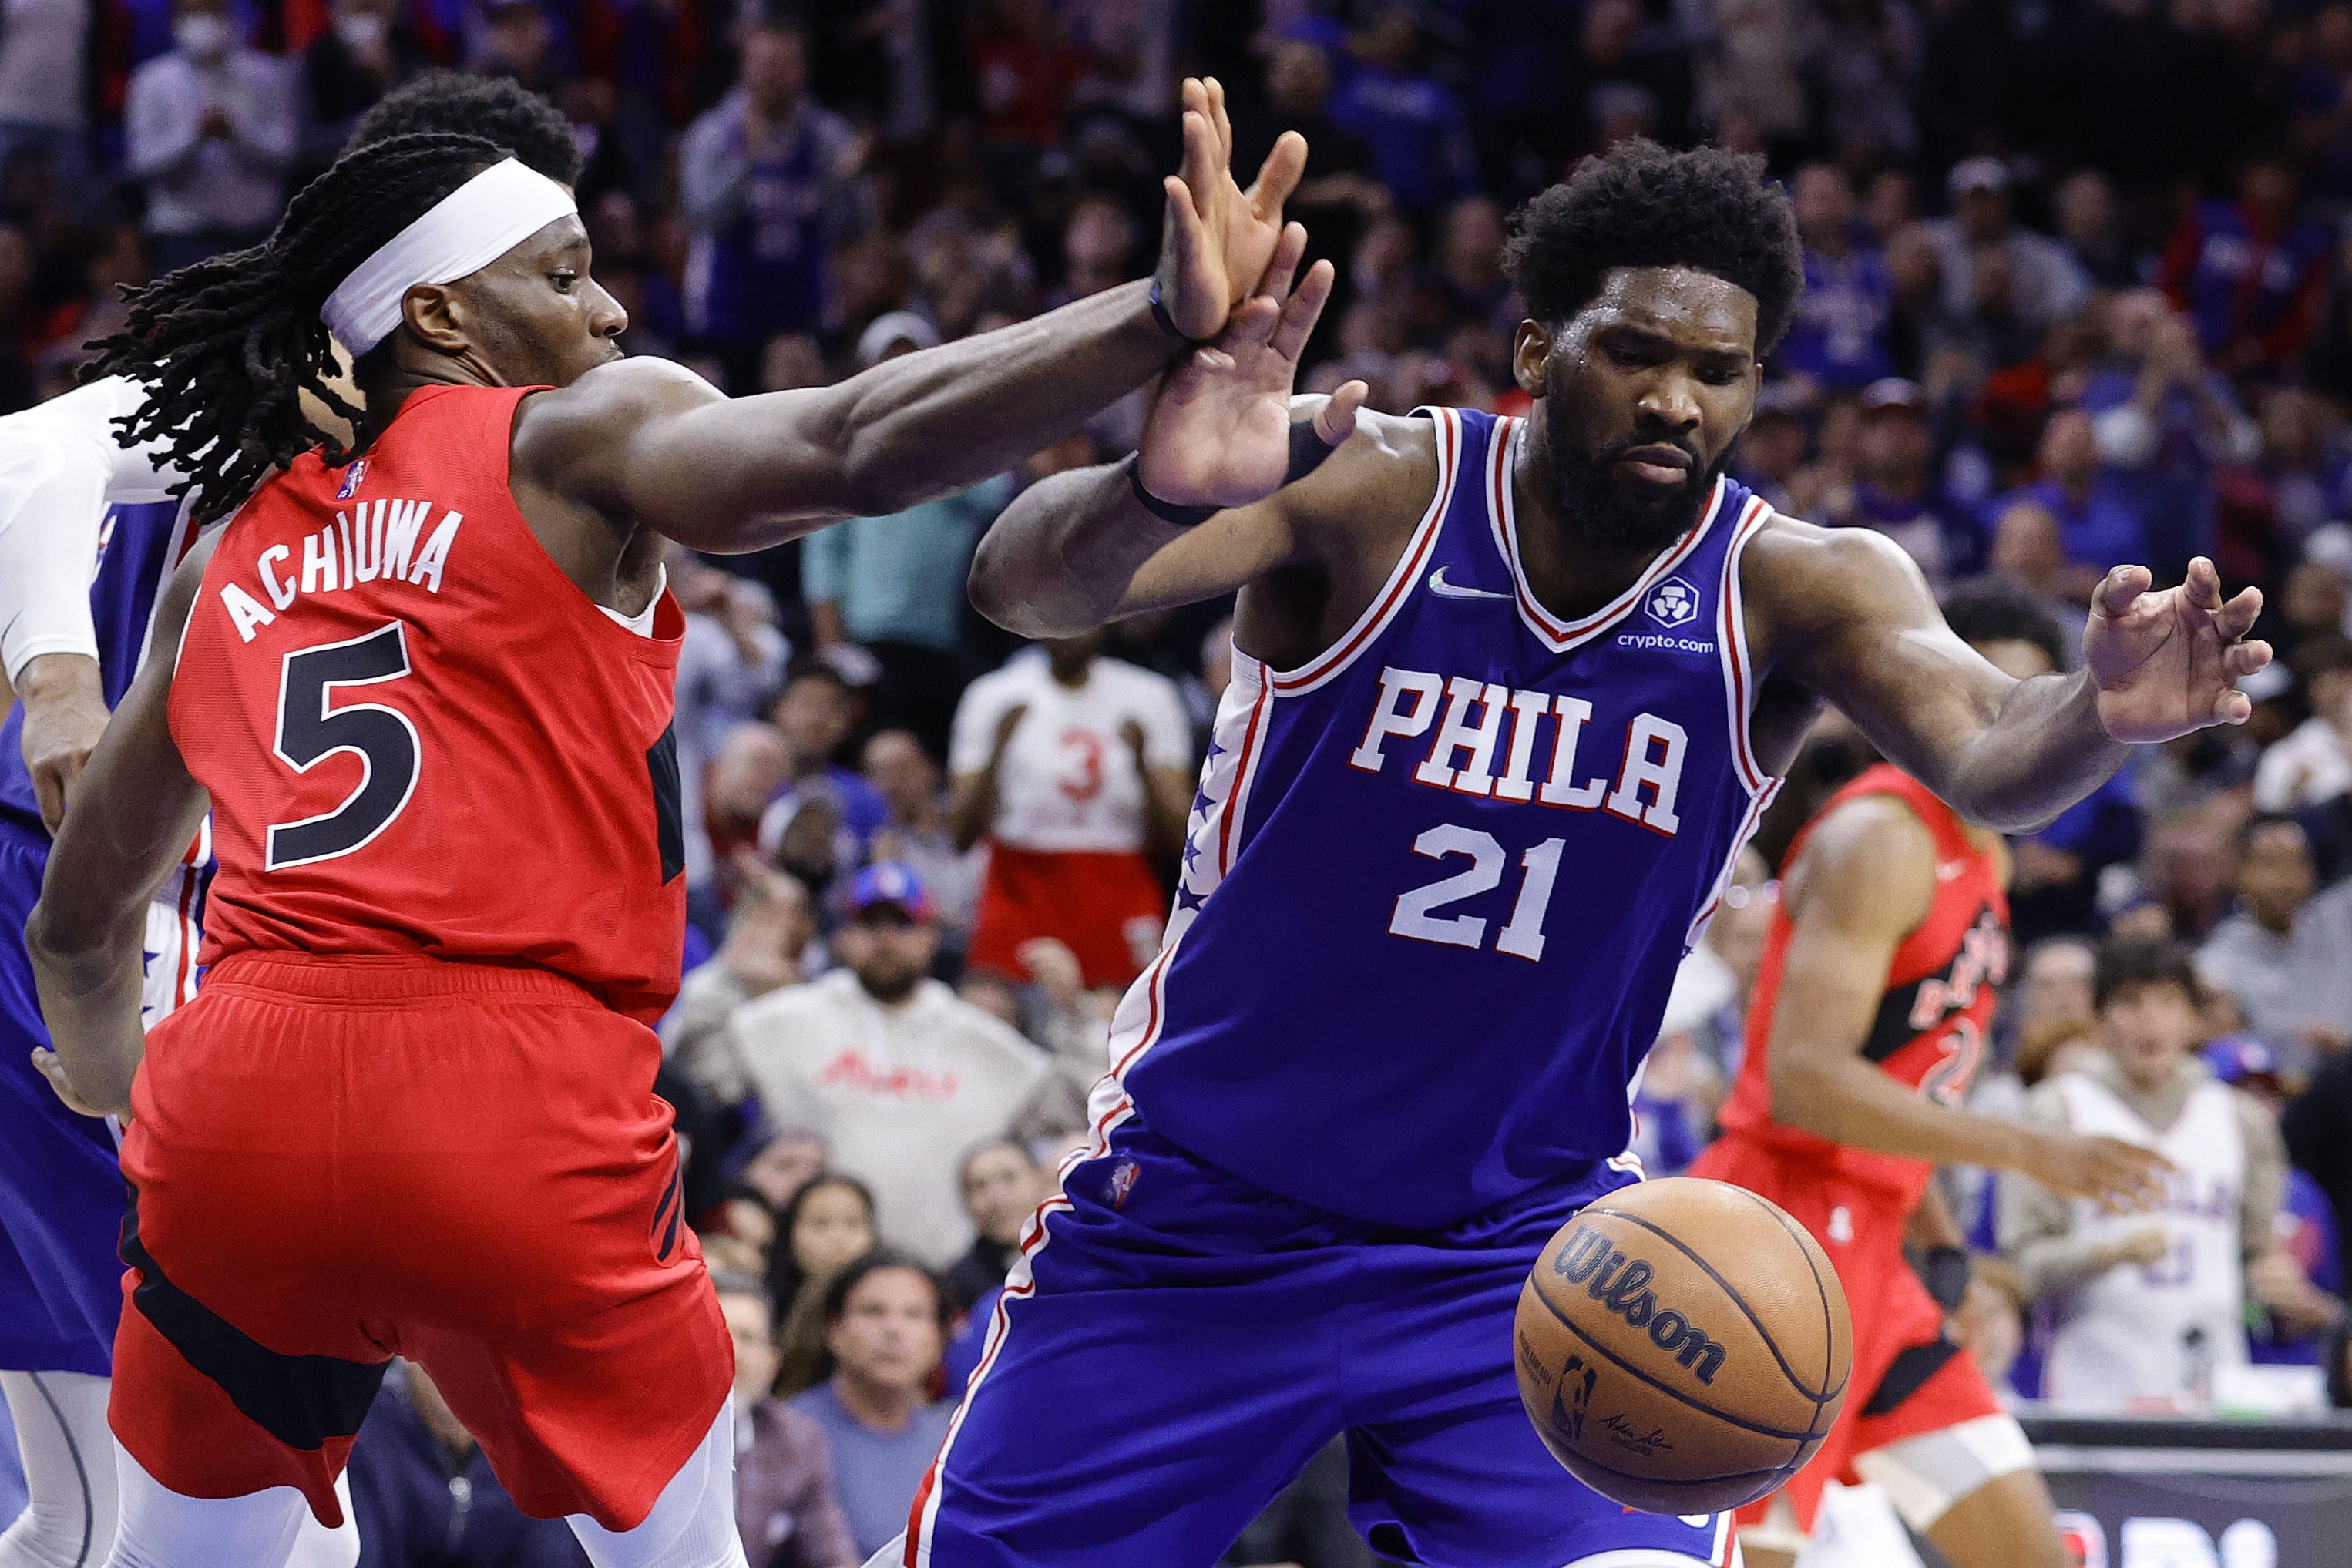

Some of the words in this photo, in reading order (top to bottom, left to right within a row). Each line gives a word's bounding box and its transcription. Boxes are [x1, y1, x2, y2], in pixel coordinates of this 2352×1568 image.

[220, 498, 463, 643] ACHIUWA
[1618, 632, 1715, 655] crypto.com
[265, 619, 422, 872] 5
[1057, 727, 1104, 803] 3
[1346, 665, 1688, 838] PHILA
[1386, 823, 1567, 963] 21
[1554, 1223, 1727, 1387] Wilson
